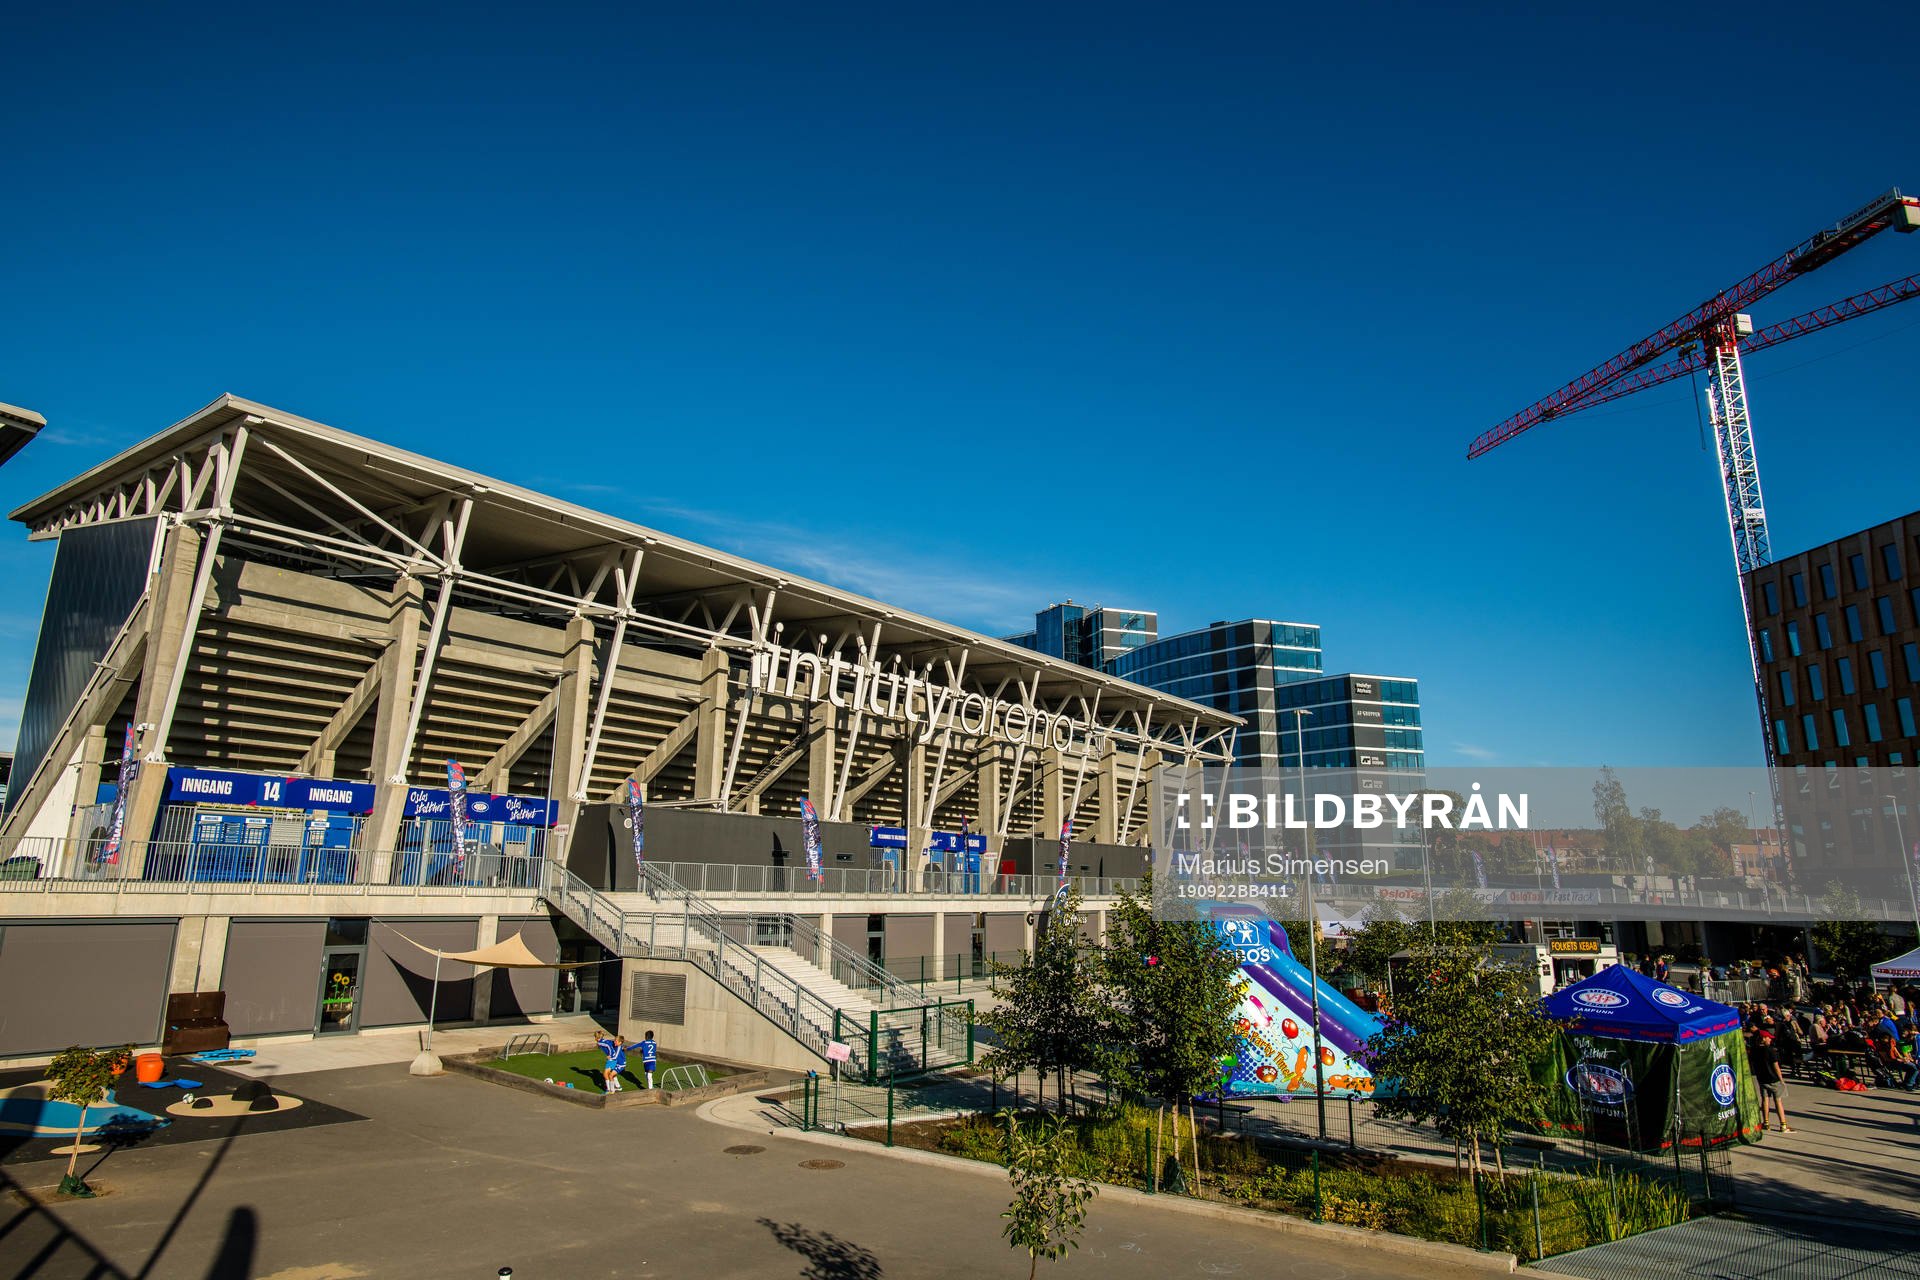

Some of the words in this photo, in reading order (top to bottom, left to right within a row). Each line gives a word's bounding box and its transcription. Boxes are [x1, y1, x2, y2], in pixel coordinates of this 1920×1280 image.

[961, 692, 1075, 752] arena
[181, 777, 233, 795] INNGANG
[263, 781, 280, 801] 14
[309, 787, 353, 804] INNGANG
[1026, 913, 1035, 926] G
[1551, 941, 1578, 951] FOLKETS
[1579, 941, 1598, 951] KEBAB
[1573, 1007, 1614, 1015] SAMFUNN
[648, 1044, 654, 1054] 2
[1250, 1031, 1276, 1057] Party
[1273, 1052, 1296, 1078] Time!
